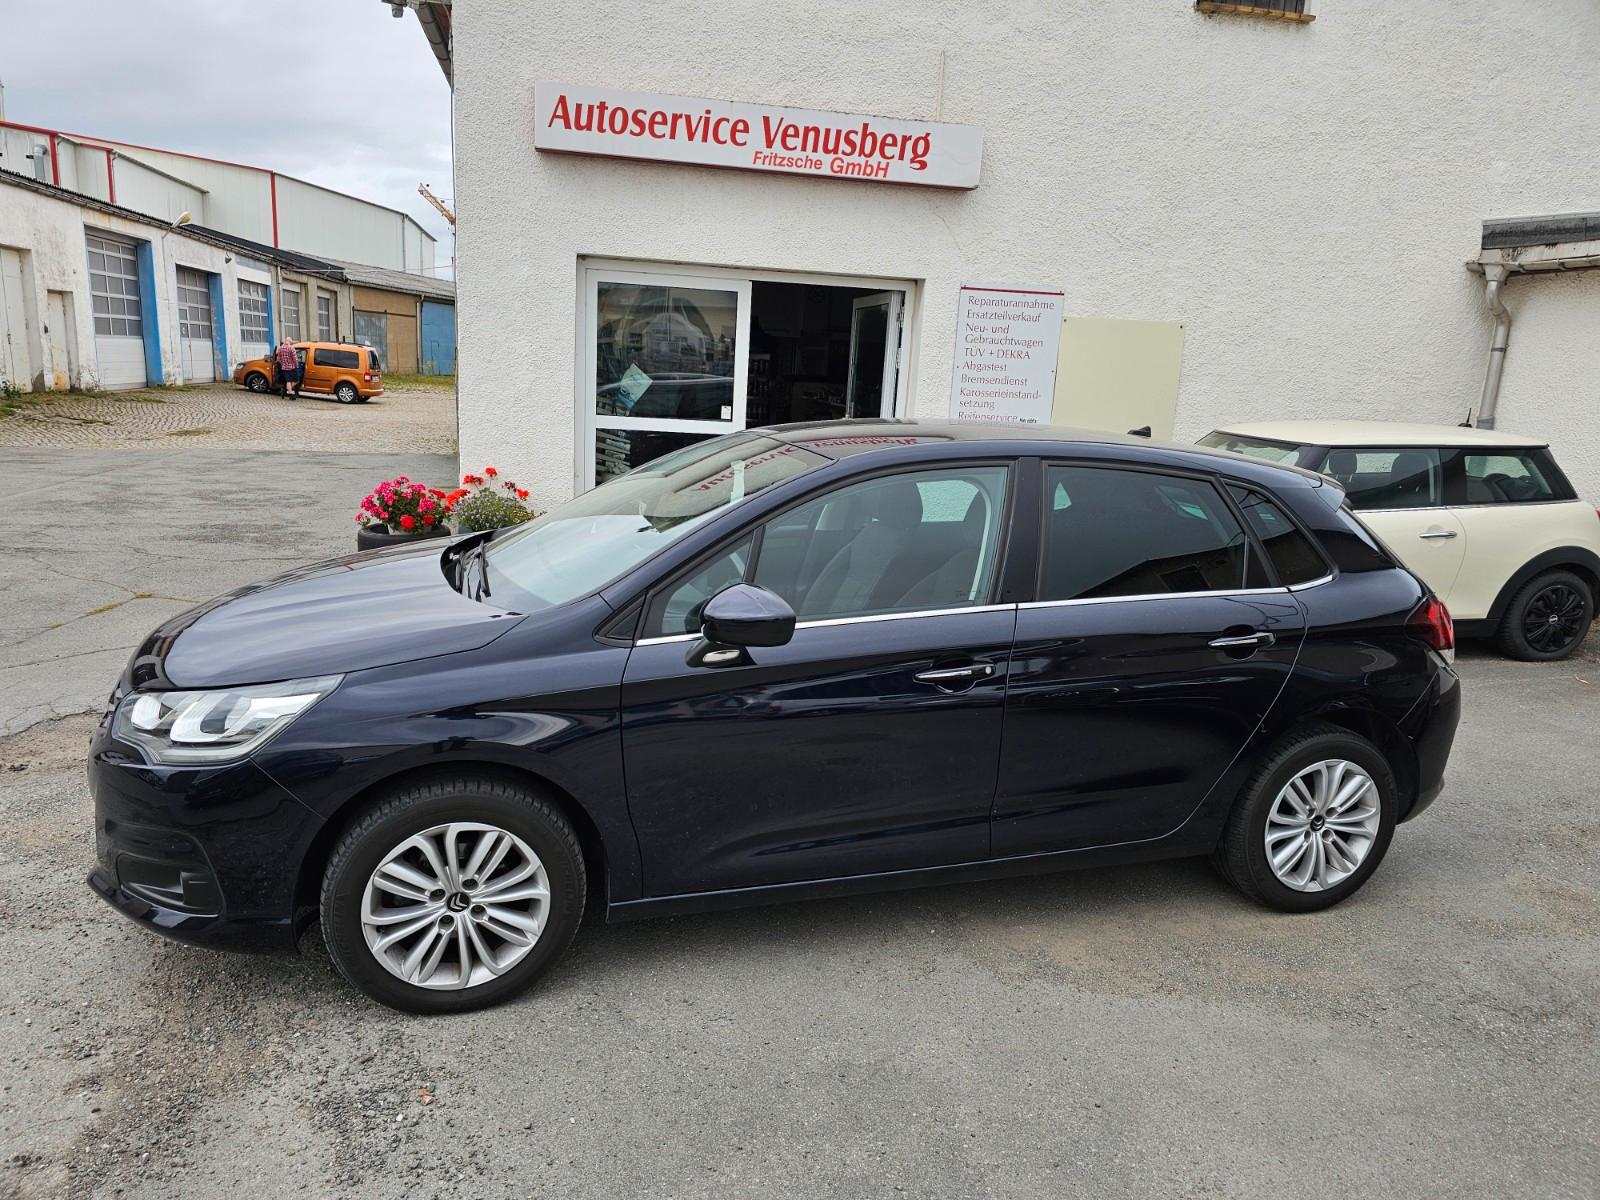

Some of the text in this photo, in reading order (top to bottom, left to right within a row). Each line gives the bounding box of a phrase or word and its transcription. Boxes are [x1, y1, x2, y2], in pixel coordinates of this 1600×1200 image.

[547, 95, 932, 171] Autoservice Venusberg
[752, 150, 891, 179] Fritzsche GmbH
[968, 296, 1055, 310] Reparaturannahme
[966, 309, 1042, 323] Ersatzteilverkauf
[965, 322, 1010, 334] Neu- und
[965, 334, 1043, 348] Gebrauchtwagen
[964, 346, 986, 357] TÜV
[996, 348, 1031, 360] DEKRA
[962, 360, 1008, 373] Abgastest
[961, 373, 1028, 386] Bremsendienst
[959, 399, 996, 411] setzung
